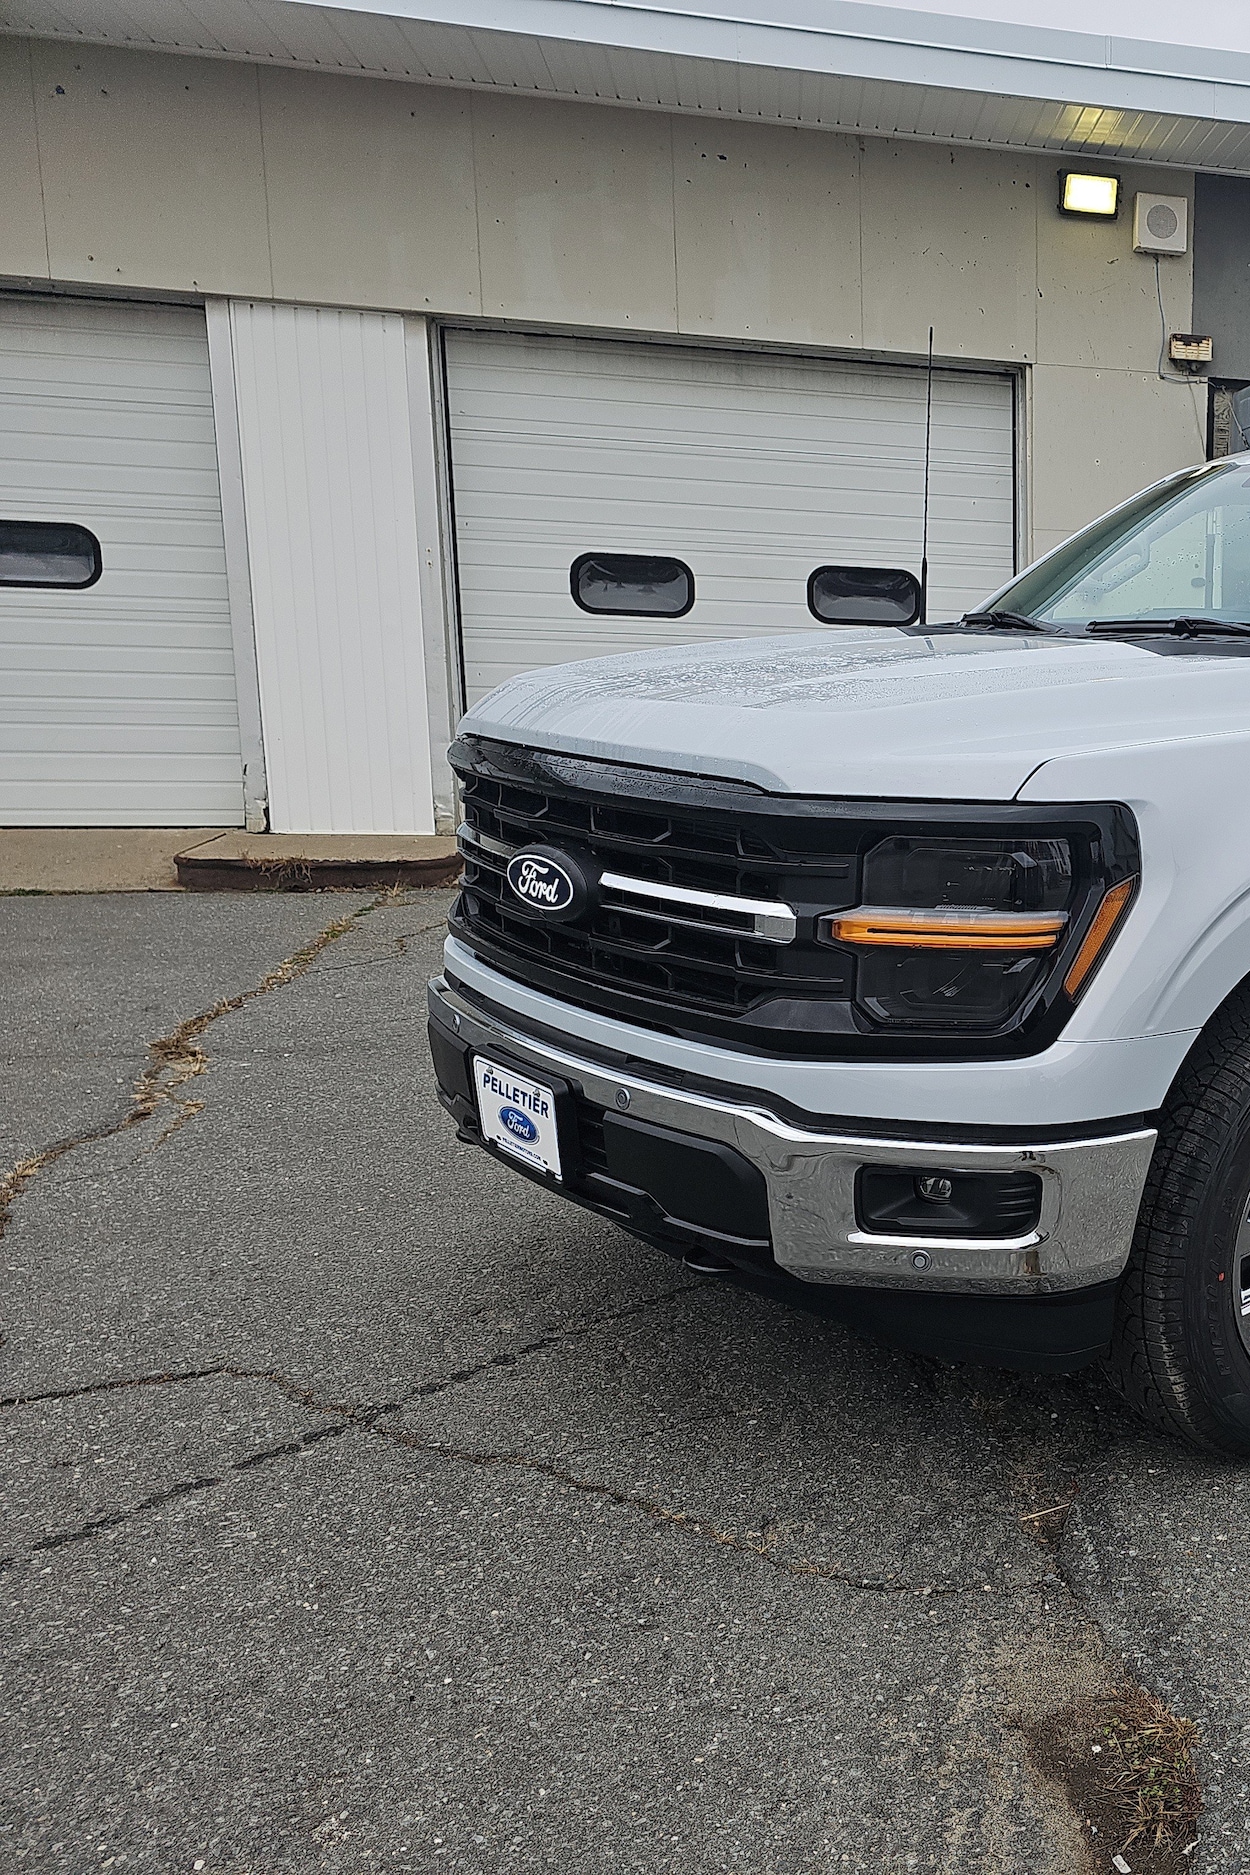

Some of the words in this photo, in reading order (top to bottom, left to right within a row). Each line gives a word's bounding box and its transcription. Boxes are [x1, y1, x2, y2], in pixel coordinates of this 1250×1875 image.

[517, 861, 560, 903] Ford
[483, 1073, 549, 1119] PELLETIER
[506, 1111, 531, 1139] Ford
